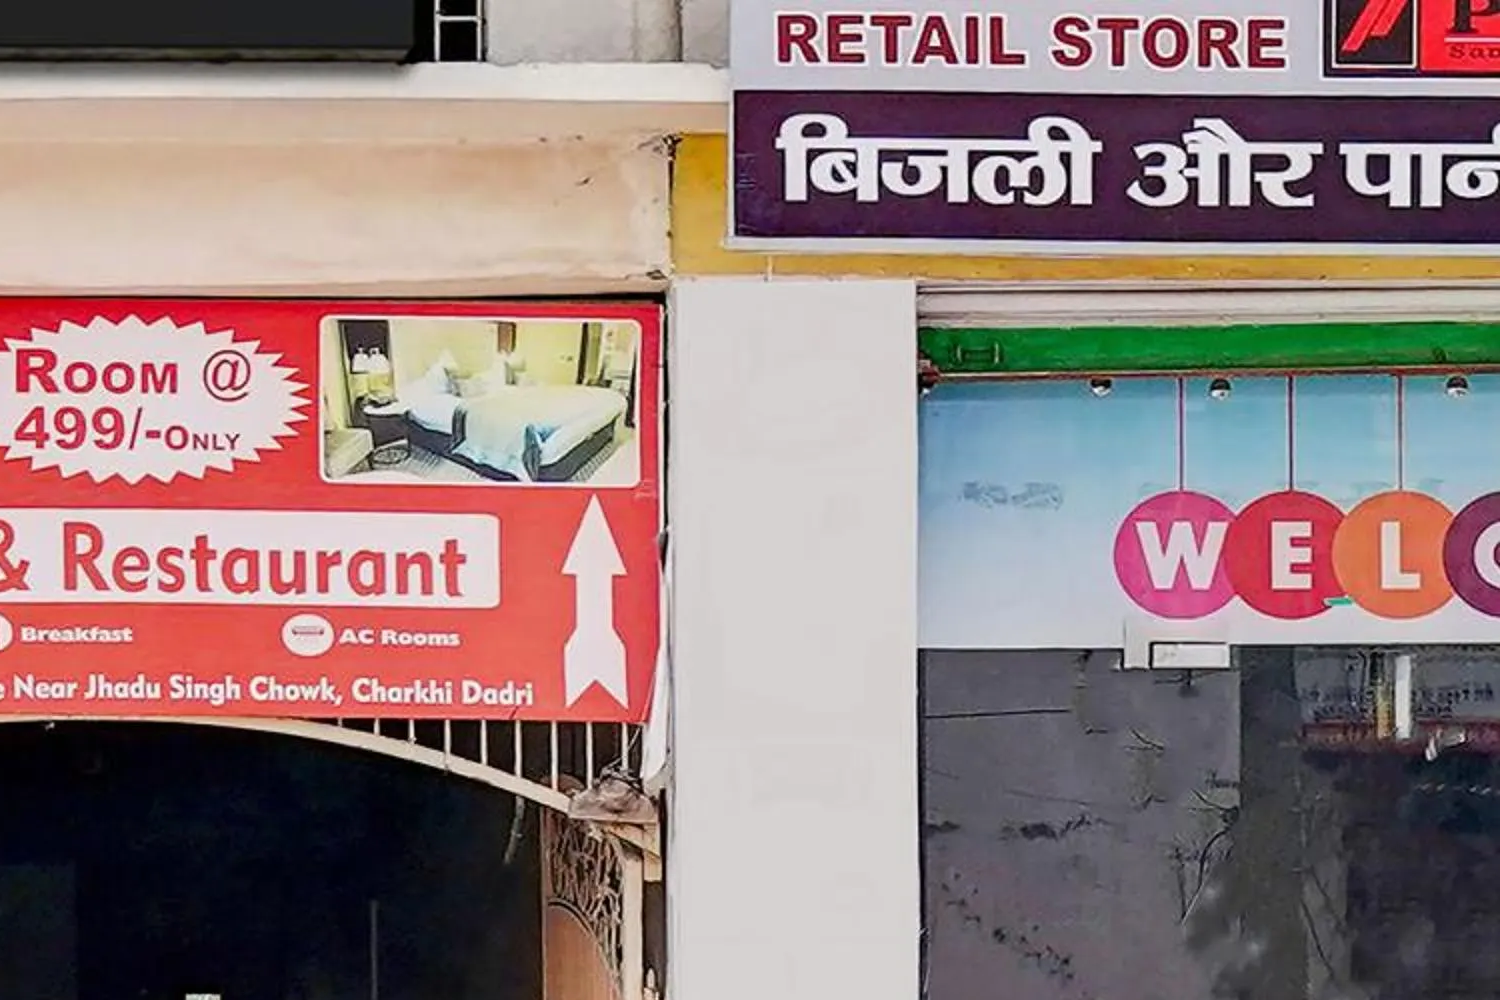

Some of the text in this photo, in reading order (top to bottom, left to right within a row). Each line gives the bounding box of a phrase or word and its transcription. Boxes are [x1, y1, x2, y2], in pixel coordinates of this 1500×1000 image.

[776, 14, 1286, 68] RETAIL STORE
[775, 113, 1500, 208] बिजली और पान
[202, 349, 251, 402] @
[62, 521, 466, 597] Restaurant
[20, 625, 133, 642] Breakfast
[338, 628, 461, 647] AC Rooms
[13, 674, 78, 699] Near
[83, 674, 161, 700] Jhadu
[169, 674, 241, 705] Singh
[250, 675, 343, 706] Chowk,
[351, 677, 453, 705] Charkhi
[461, 679, 534, 706] Dadri
